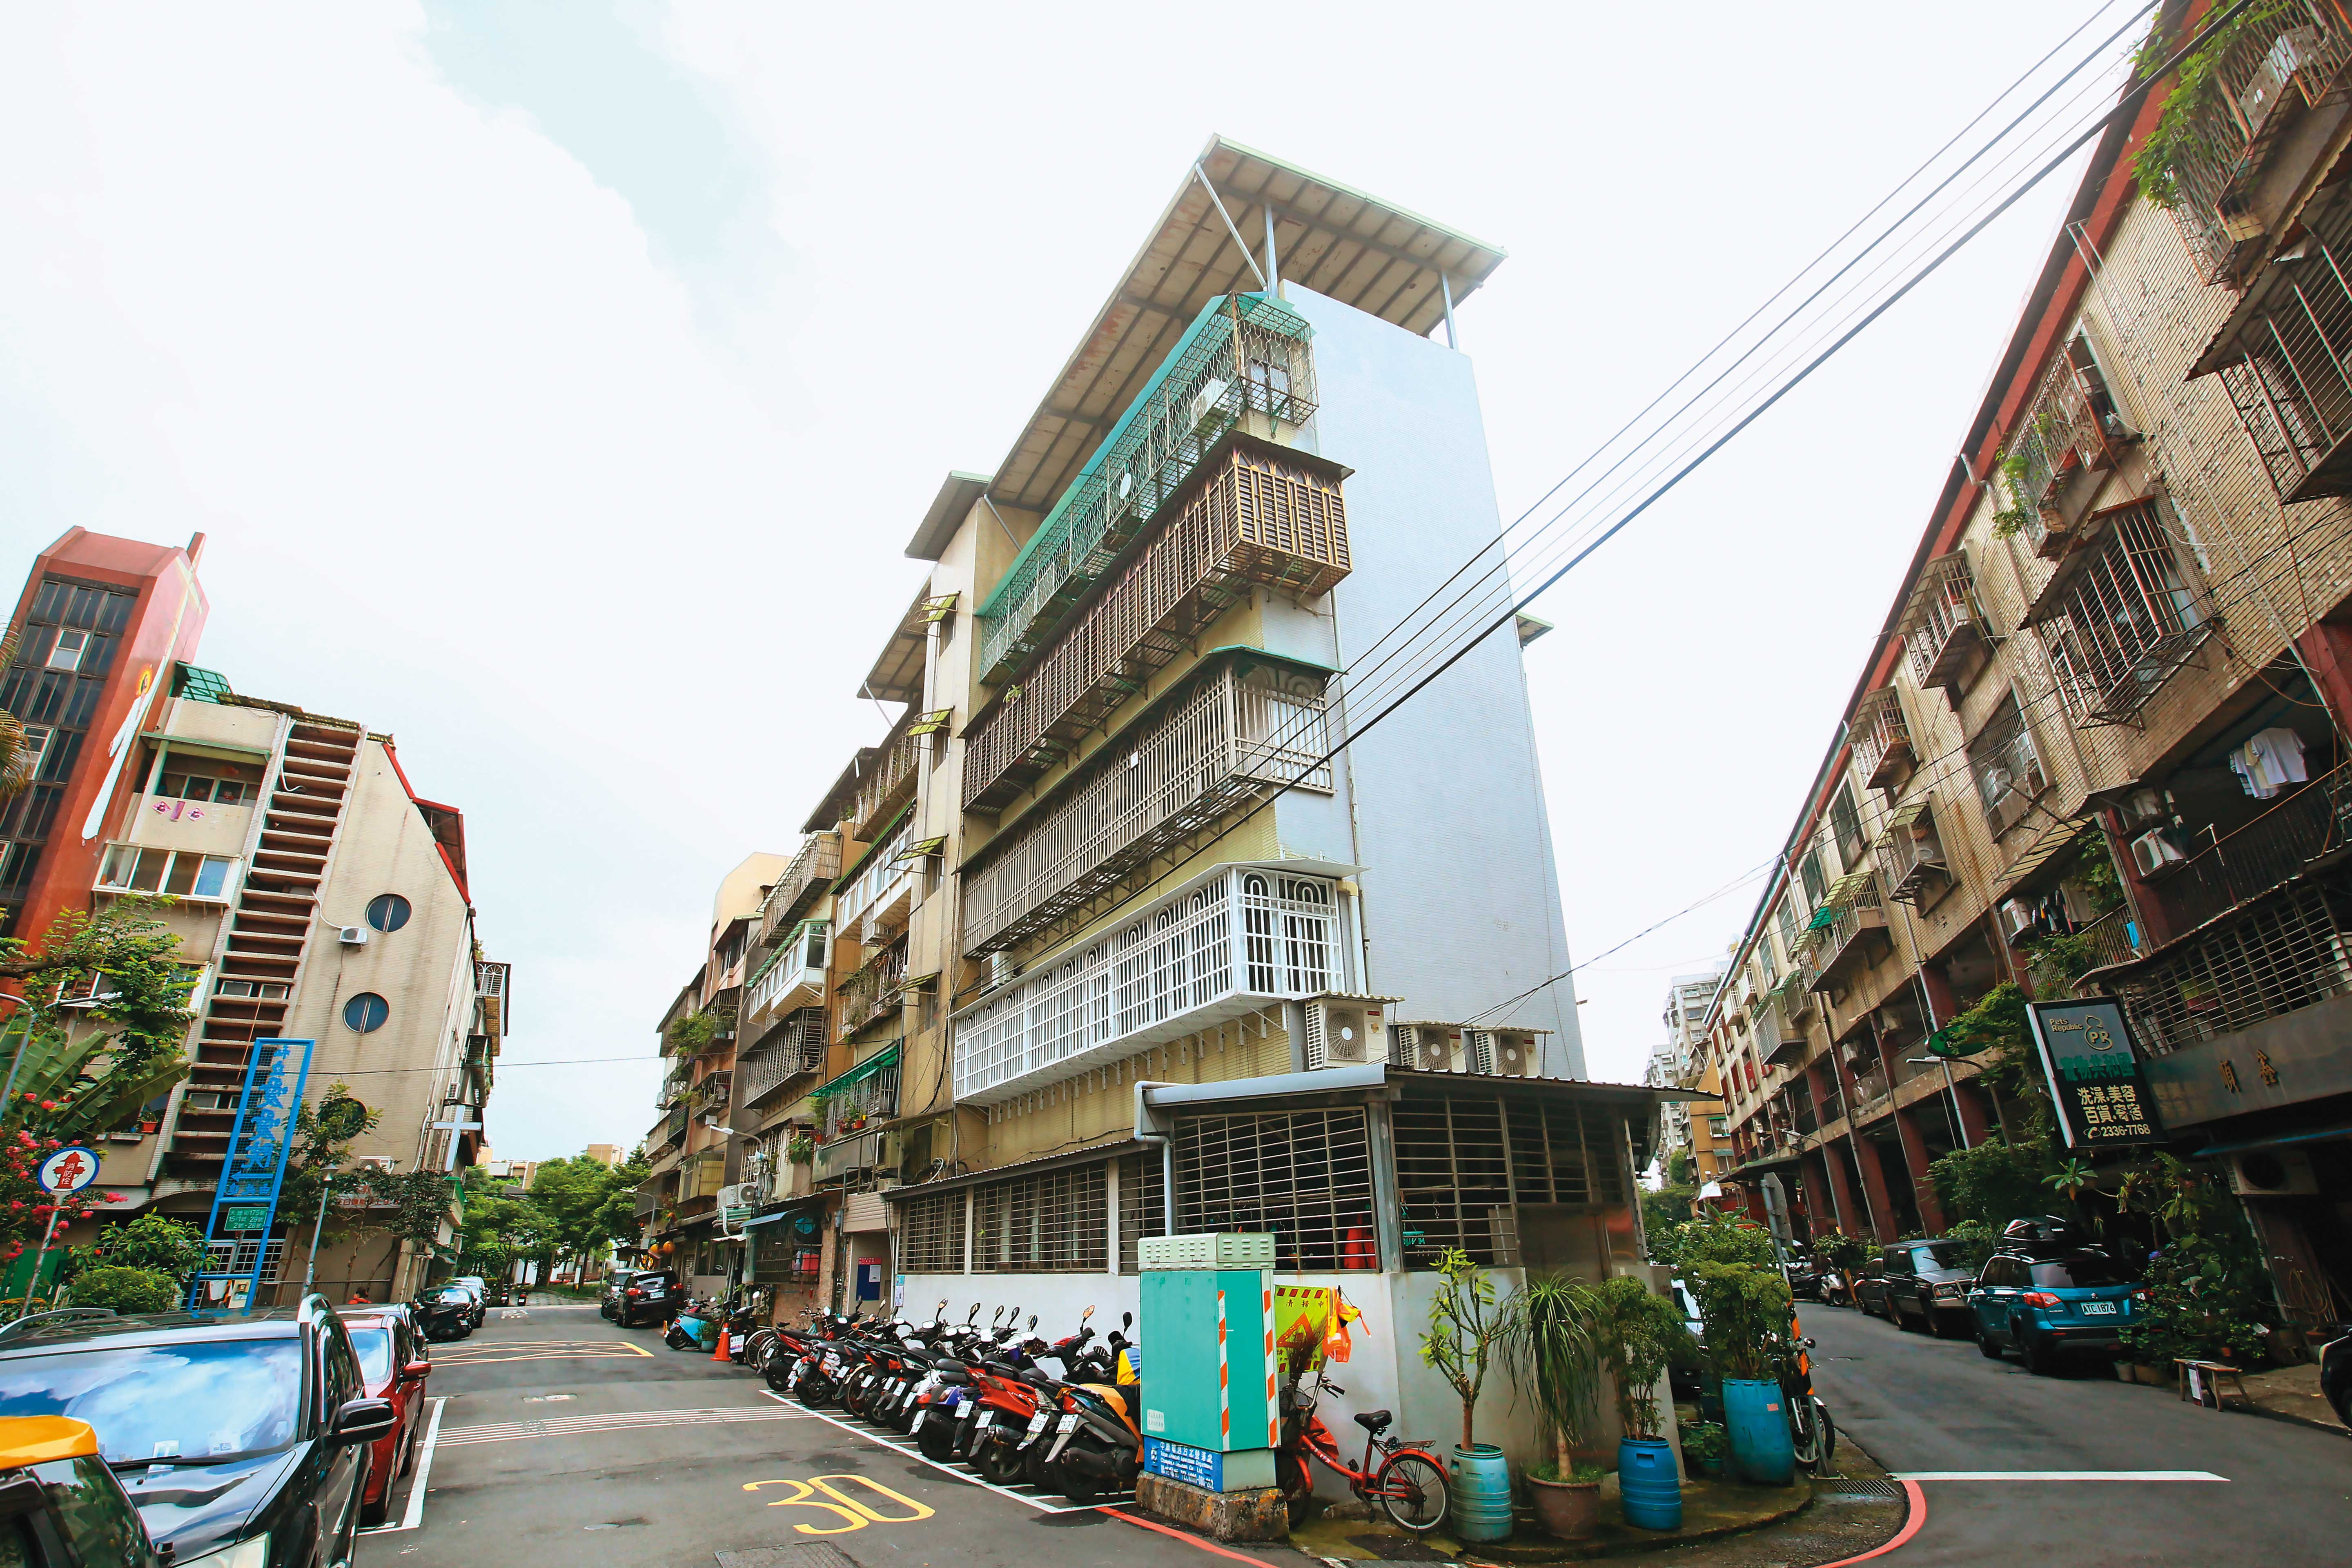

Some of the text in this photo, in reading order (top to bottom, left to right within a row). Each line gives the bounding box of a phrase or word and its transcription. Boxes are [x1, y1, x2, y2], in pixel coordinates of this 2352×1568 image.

[2051, 1024, 2083, 1032] Republic
[2060, 1052, 2136, 1081] 寵物共和國
[2101, 1124, 2150, 1137] 2336-7768
[61, 1163, 76, 1185] 消防栓
[1286, 1299, 1324, 1308] 清掃中
[2083, 1303, 2115, 1313] ATC-1876
[742, 1474, 935, 1535] 30
